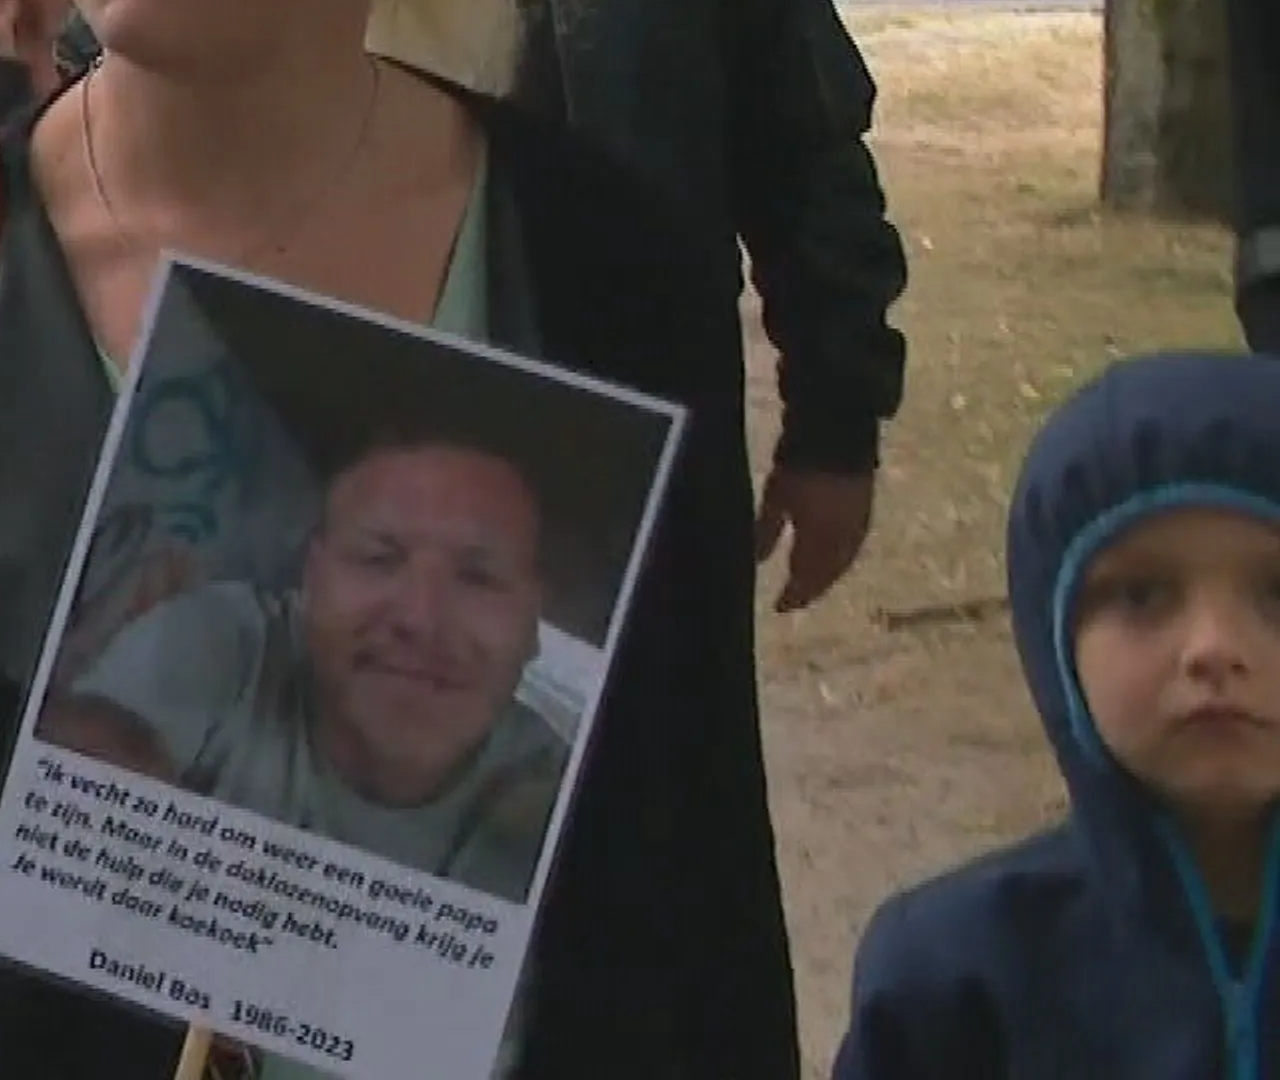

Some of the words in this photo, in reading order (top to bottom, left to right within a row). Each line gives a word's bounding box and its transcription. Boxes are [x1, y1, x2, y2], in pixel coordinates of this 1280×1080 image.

[11, 852, 36, 878] Je
[41, 867, 107, 902] wordt
[112, 888, 163, 918] daar
[16, 824, 59, 853] niet
[63, 839, 92, 861] de
[95, 847, 146, 881] hulp
[149, 869, 184, 893] die
[184, 879, 210, 904] je
[213, 890, 279, 929] nodig
[282, 912, 338, 950] hebt.
[24, 791, 48, 813] te
[100, 816, 163, 852] Maar
[167, 839, 189, 862] in
[193, 847, 223, 872] de
[226, 860, 410, 942] daklozenopvang
[414, 924, 468, 962] krijg
[467, 944, 494, 970] je
[71, 774, 130, 808] vecht
[132, 795, 158, 818] zo
[162, 800, 219, 834] hard
[220, 827, 256, 850] om
[262, 840, 320, 870] weer
[323, 862, 365, 888] een
[368, 880, 434, 911] goeie
[436, 902, 498, 934] papa
[89, 948, 164, 992] Daniel
[169, 979, 211, 1010] Bos
[230, 999, 354, 1062] 1986-2023
